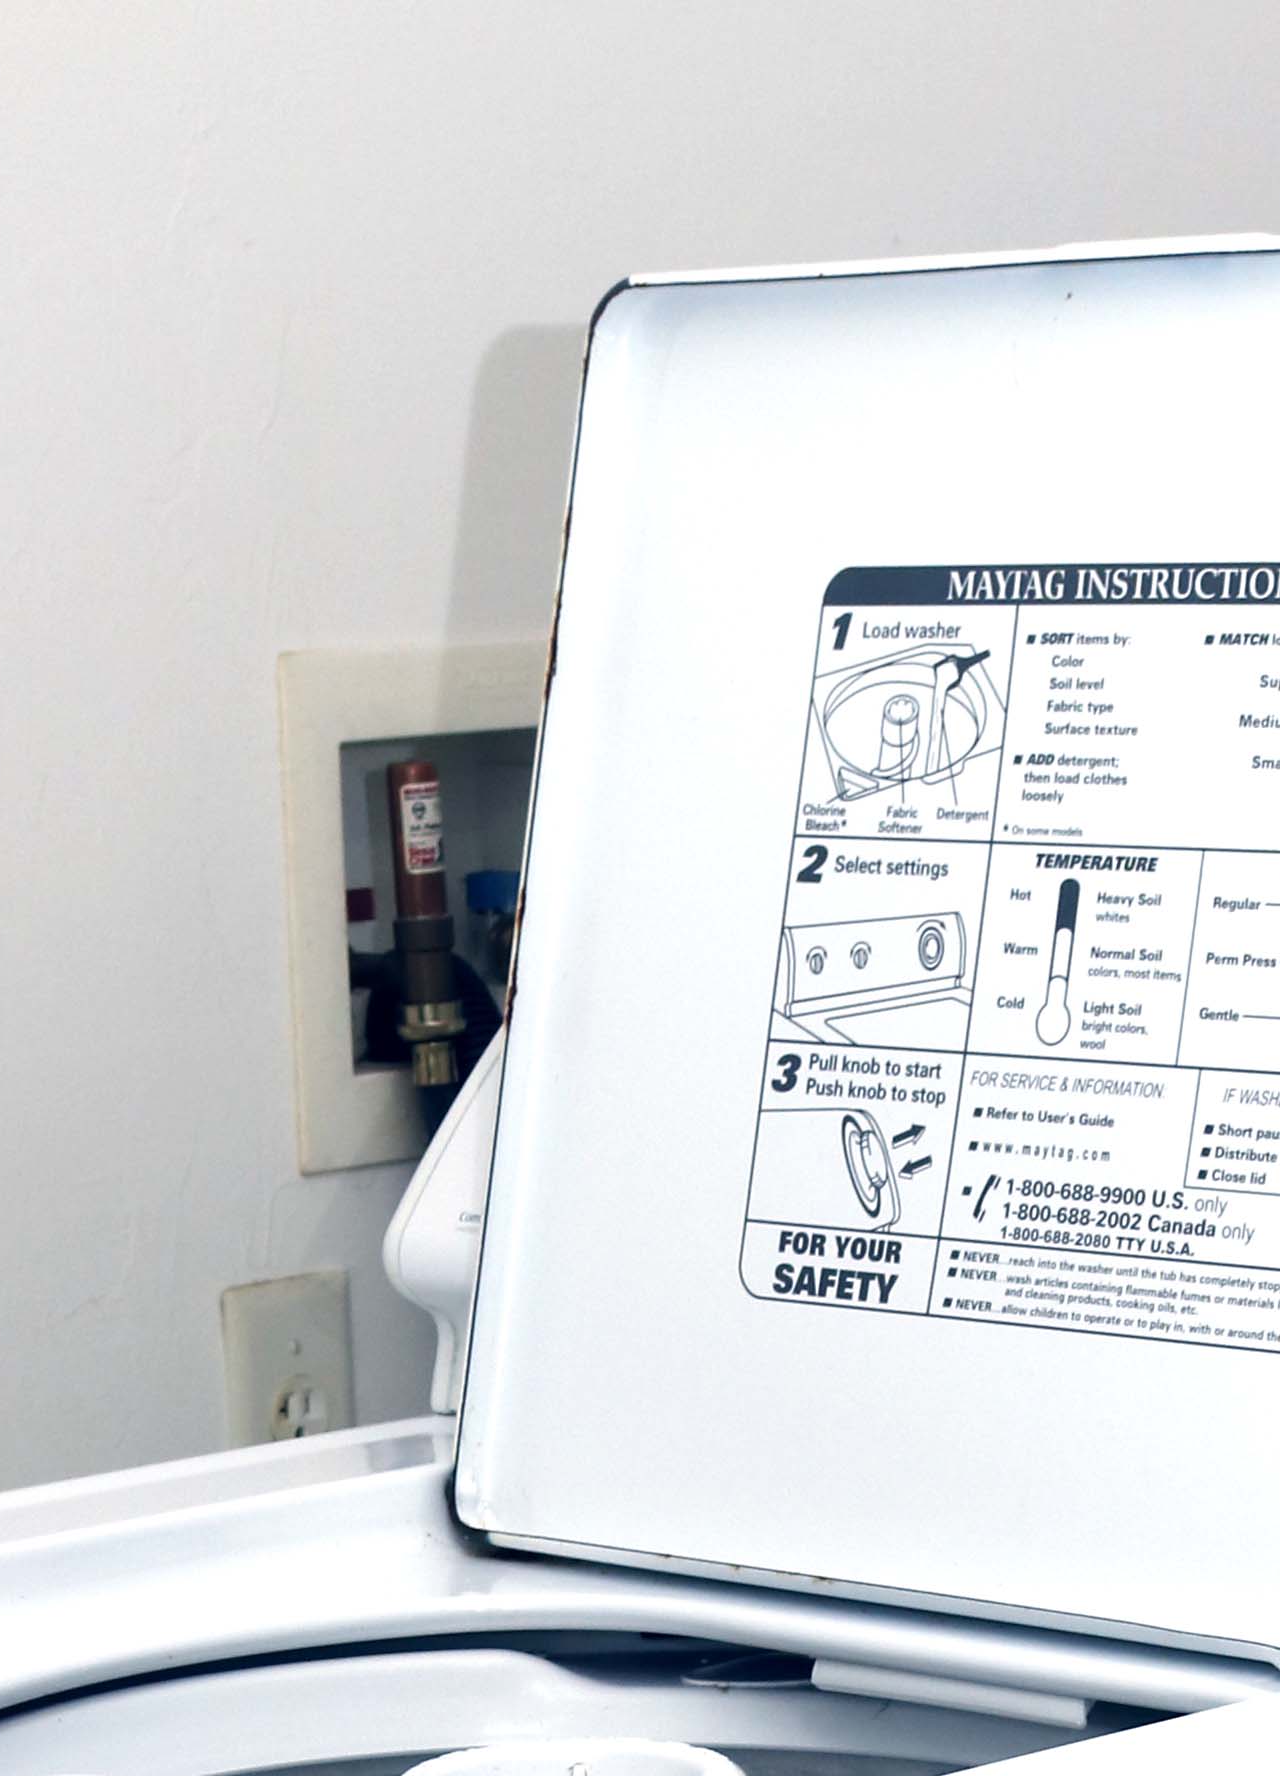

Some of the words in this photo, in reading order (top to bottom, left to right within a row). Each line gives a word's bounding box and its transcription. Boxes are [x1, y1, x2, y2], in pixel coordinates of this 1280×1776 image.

[947, 570, 1065, 600] MAYTAG
[833, 612, 852, 650] 1
[863, 622, 901, 638] Load
[905, 622, 961, 638] washer
[1040, 633, 1074, 644] SORT
[1077, 634, 1109, 644] items
[1220, 634, 1269, 645] MATCH
[1052, 655, 1084, 667] Color
[1050, 678, 1072, 690] Soil
[1076, 678, 1104, 690] level
[1047, 700, 1083, 712] Fabric
[1088, 702, 1114, 714] type
[1045, 722, 1090, 735] Surface
[1095, 725, 1138, 736] texture
[1027, 754, 1054, 765] ADD
[1024, 772, 1050, 783] then
[1054, 772, 1080, 784] load
[1084, 773, 1127, 785] clothes
[1022, 789, 1064, 804] loosely
[803, 804, 846, 816] Chlorine
[887, 806, 917, 818] Fabric
[936, 808, 989, 823] Detergent
[878, 821, 922, 834] Softener
[796, 845, 828, 883] 2
[834, 855, 882, 874] Select
[886, 858, 948, 880] settings
[1036, 854, 1158, 872] TEMPERATURE
[1010, 888, 1031, 900] Hot
[1097, 892, 1134, 907] Heavy
[1138, 893, 1162, 906] Soil
[1213, 896, 1261, 912] Regular
[1096, 912, 1130, 923] whites
[1004, 942, 1038, 955] Warm
[1090, 946, 1135, 960] Normal
[1139, 949, 1162, 961] Soil
[1206, 952, 1238, 965] Perm
[1243, 954, 1276, 967] Press
[1124, 970, 1150, 979] most
[1153, 970, 1181, 982] items
[997, 996, 1024, 1009] Cold
[1084, 1001, 1114, 1016] Light
[1118, 1003, 1142, 1016] Soil
[1199, 1008, 1239, 1022] Gentle
[1082, 1020, 1112, 1034] bright
[1080, 1040, 1106, 1050] wool
[772, 1054, 802, 1092] 3
[809, 1053, 838, 1071] Pull
[842, 1056, 880, 1074] knob
[886, 1060, 900, 1076] to
[906, 1062, 942, 1079] start
[970, 1070, 998, 1086] FOR
[1000, 1072, 1058, 1091] SERVICE
[1060, 1077, 1068, 1092] &
[806, 1078, 843, 1096] Push
[848, 1080, 886, 1100] knob
[892, 1086, 907, 1101] to
[912, 1088, 946, 1108] stop
[1223, 1088, 1236, 1102] IF
[987, 1107, 1018, 1120] Refer
[1022, 1111, 1034, 1121] to
[1038, 1110, 1074, 1124] User's
[1079, 1114, 1114, 1128] Guide
[1218, 1124, 1252, 1138] Short
[1215, 1146, 1277, 1162] Distribute
[1212, 1169, 1246, 1183] Close
[1250, 1172, 1266, 1184] lid
[1008, 1179, 1146, 1206] 1-800-688-9900
[1152, 1190, 1188, 1210] U.S.
[1194, 1196, 1228, 1218] only
[1003, 1202, 1142, 1231] 1-800-688-2002
[1148, 1214, 1216, 1237] Canada
[1222, 1223, 1255, 1245] only
[779, 1230, 826, 1256] FOR
[836, 1236, 902, 1264] YOUR
[1000, 1226, 1110, 1249] 1-800-688-2080
[1116, 1236, 1145, 1251] TTY
[1151, 1240, 1194, 1256] U.S.A.
[1038, 1258, 1056, 1270] into
[1060, 1262, 1074, 1271] the
[1078, 1264, 1113, 1274] washer
[1116, 1268, 1138, 1276] until
[1142, 1269, 1156, 1278] the
[1160, 1272, 1176, 1280] tub
[1180, 1272, 1196, 1283] has
[1200, 1276, 1256, 1291] completely
[773, 1263, 898, 1304] SAFETY
[1005, 1288, 1023, 1297] and
[1025, 1288, 1065, 1304] cleaning
[1116, 1299, 1154, 1313] cooking
[1034, 1278, 1068, 1288] articles
[1071, 1282, 1123, 1296] containing
[1126, 1284, 1178, 1299] flammable
[1181, 1290, 1211, 1302] fumes
[1228, 1298, 1274, 1309] materials
[1030, 1307, 1068, 1320] children
[1072, 1312, 1081, 1321] to
[1084, 1314, 1121, 1325] operate
[1124, 1318, 1134, 1326] or
[1138, 1319, 1147, 1328] to
[1150, 1319, 1171, 1332] play
[1190, 1325, 1211, 1334] with
[1214, 1328, 1224, 1336] or
[1228, 1330, 1264, 1340] around
